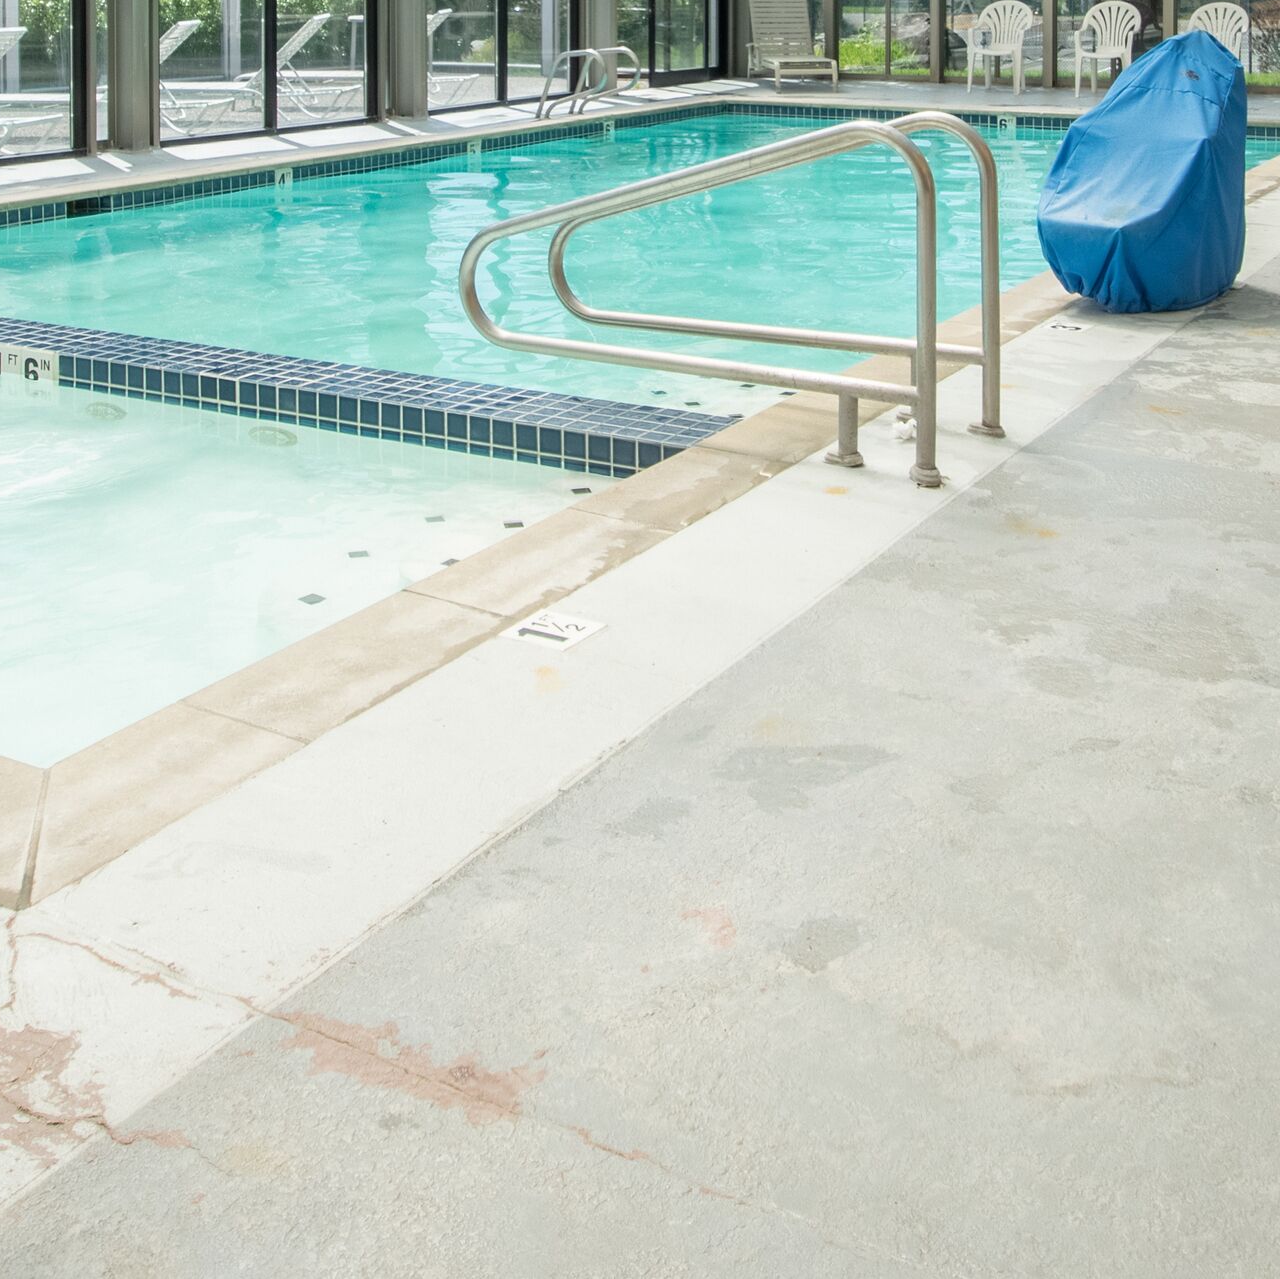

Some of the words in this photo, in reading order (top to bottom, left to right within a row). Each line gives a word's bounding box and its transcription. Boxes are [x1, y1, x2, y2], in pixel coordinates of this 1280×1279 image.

[8, 354, 18, 366] FT
[24, 357, 39, 380] 6
[41, 360, 51, 371] IN
